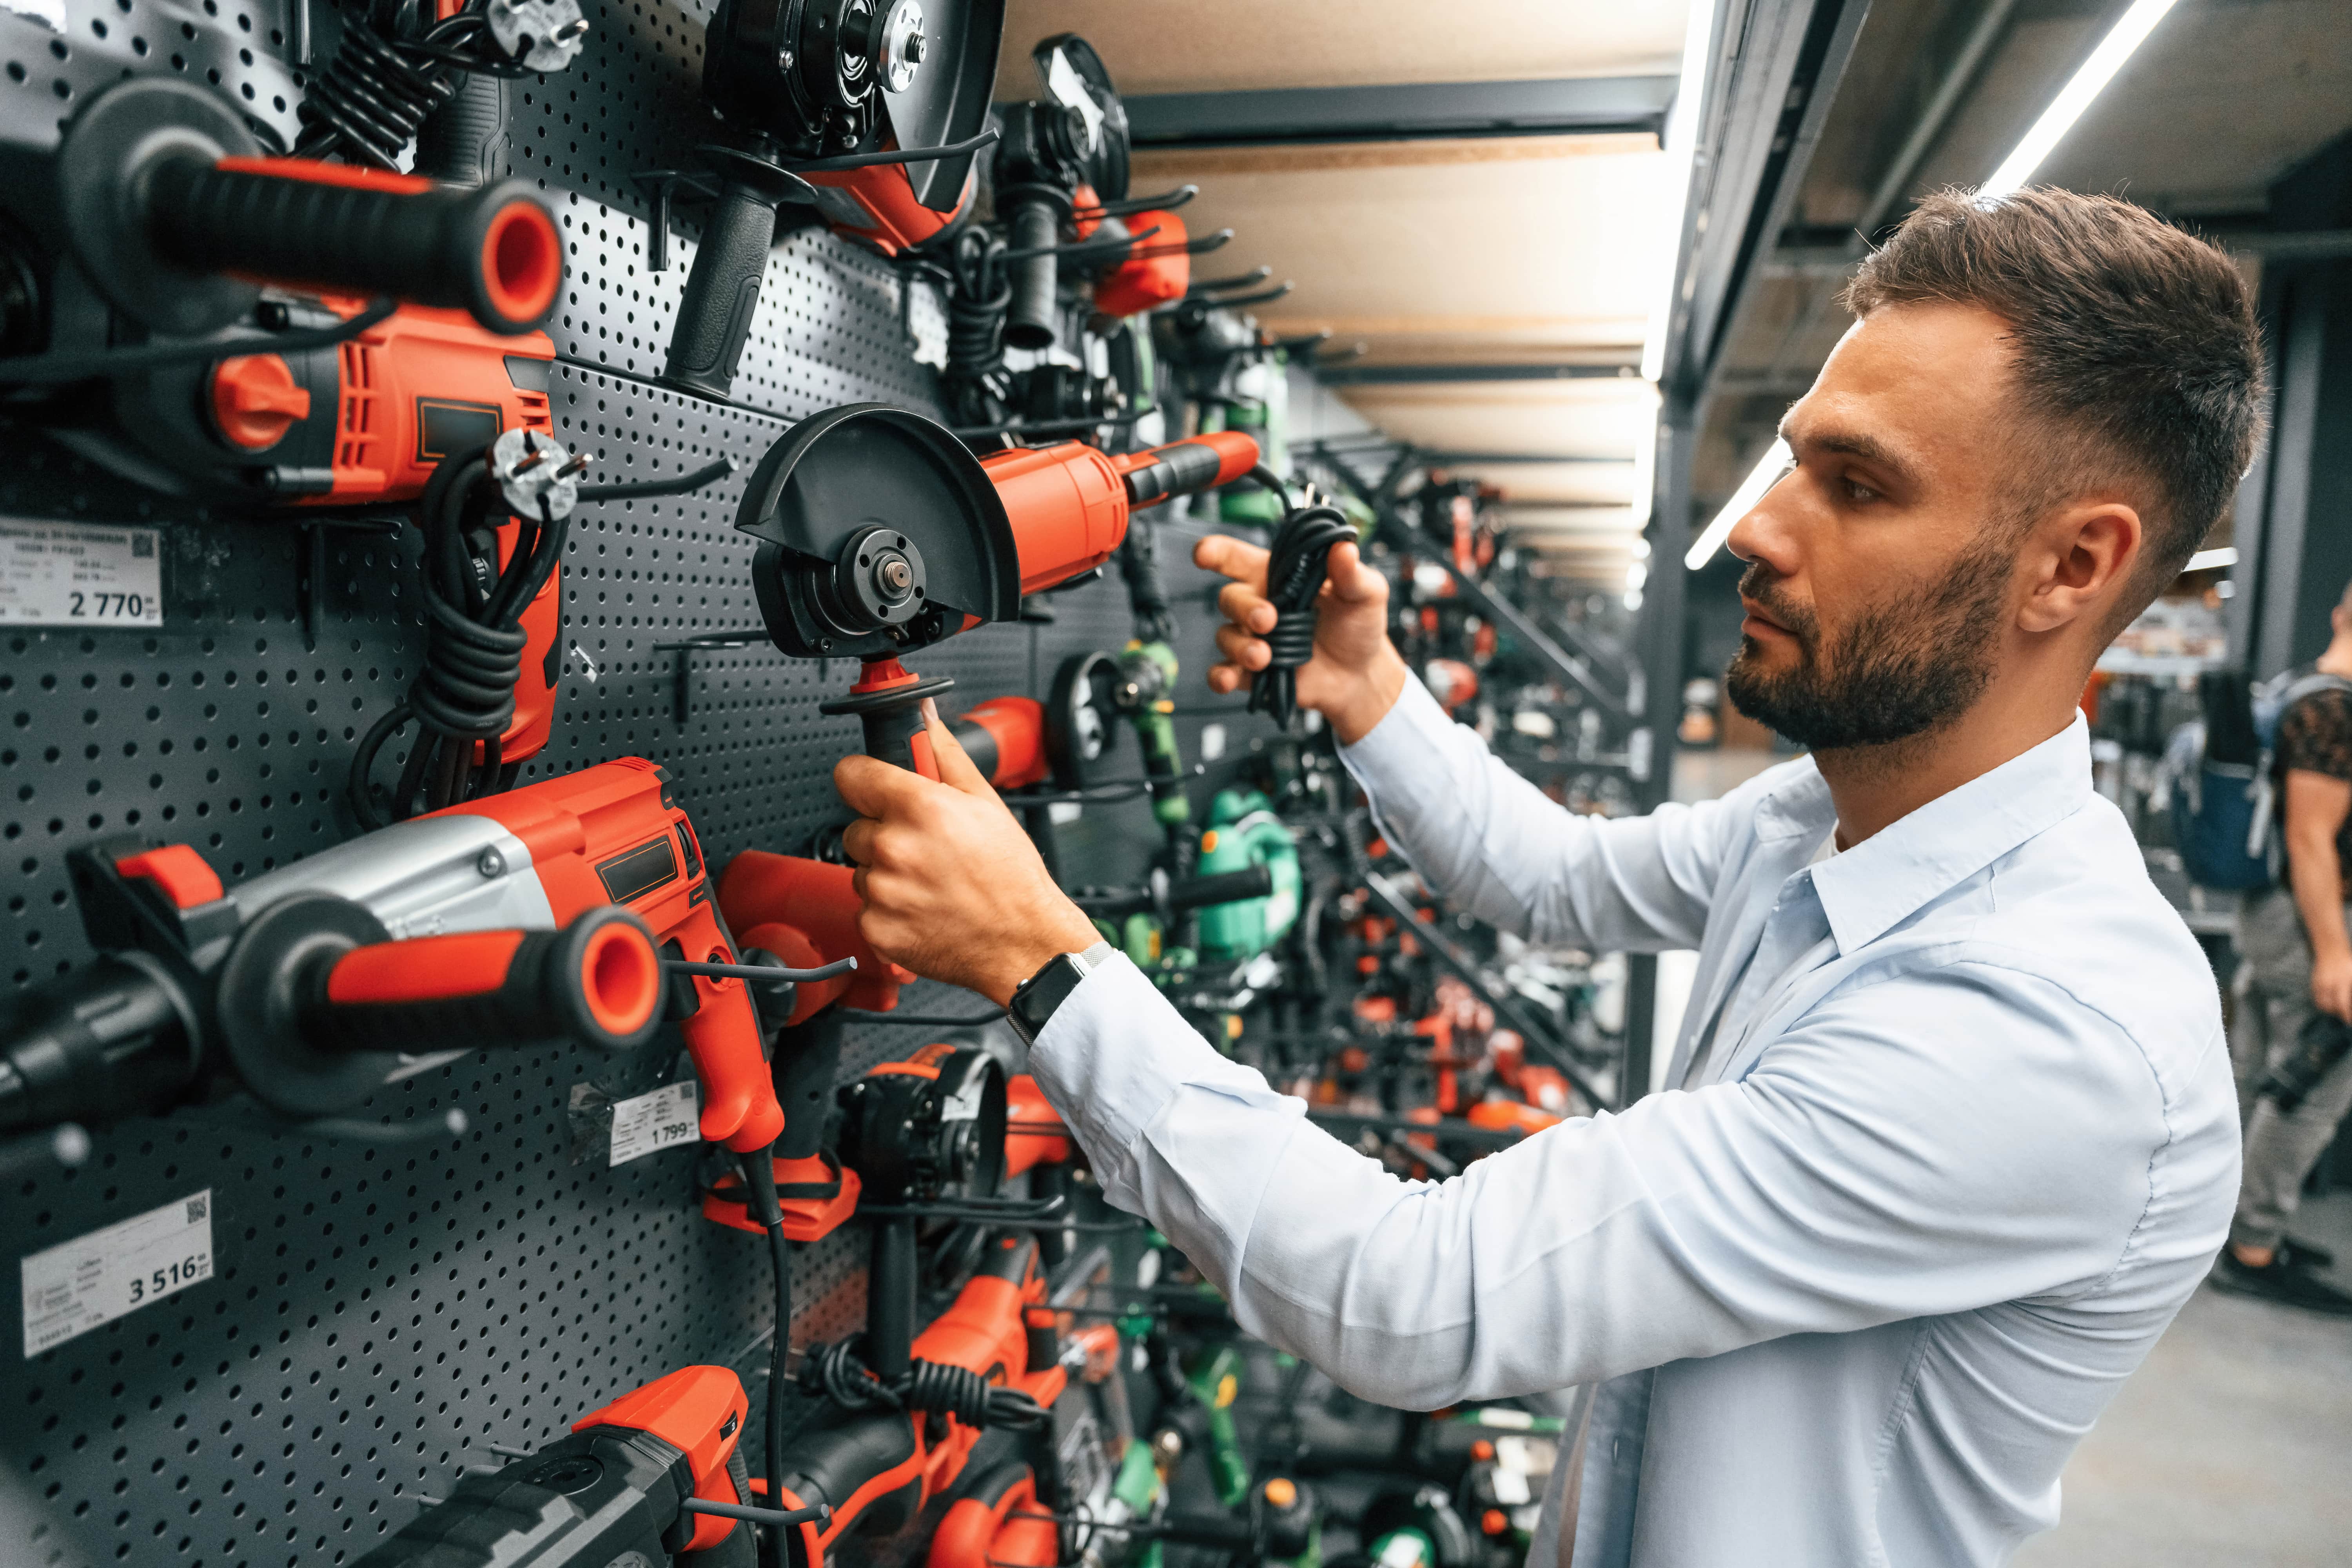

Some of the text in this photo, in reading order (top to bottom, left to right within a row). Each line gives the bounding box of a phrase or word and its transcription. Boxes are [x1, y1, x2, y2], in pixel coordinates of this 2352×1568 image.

[71, 591, 85, 616] 2
[94, 592, 142, 617] 770
[653, 1130, 658, 1144] 1
[663, 1122, 687, 1142] 799
[129, 1279, 143, 1303] 3
[153, 1255, 195, 1293] 516
[732, 1422, 735, 1431] 2
